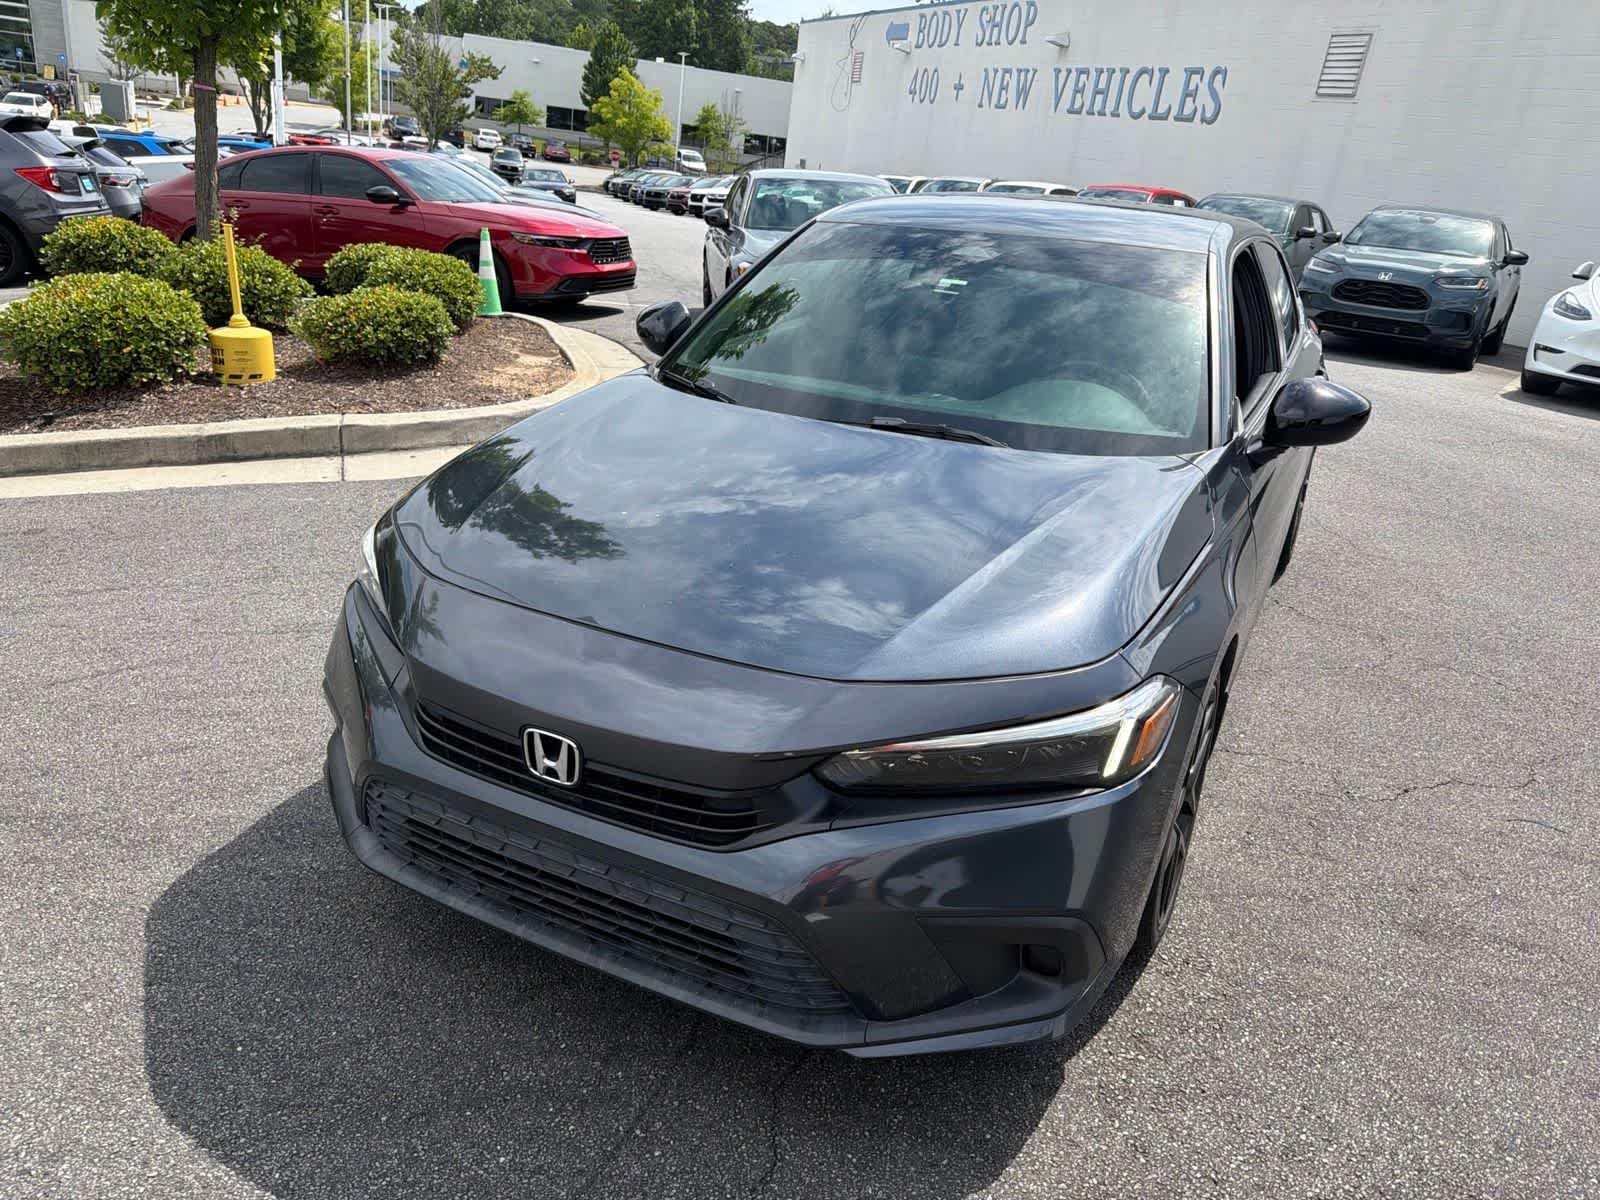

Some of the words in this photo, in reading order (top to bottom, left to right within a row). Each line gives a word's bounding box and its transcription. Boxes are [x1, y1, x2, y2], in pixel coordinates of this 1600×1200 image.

[914, 8, 968, 48] BODY
[975, 0, 1038, 47] SHOP
[908, 66, 939, 105] 400
[953, 72, 964, 102] +
[977, 67, 1038, 111] NEW
[1053, 65, 1228, 126] VEHICLES
